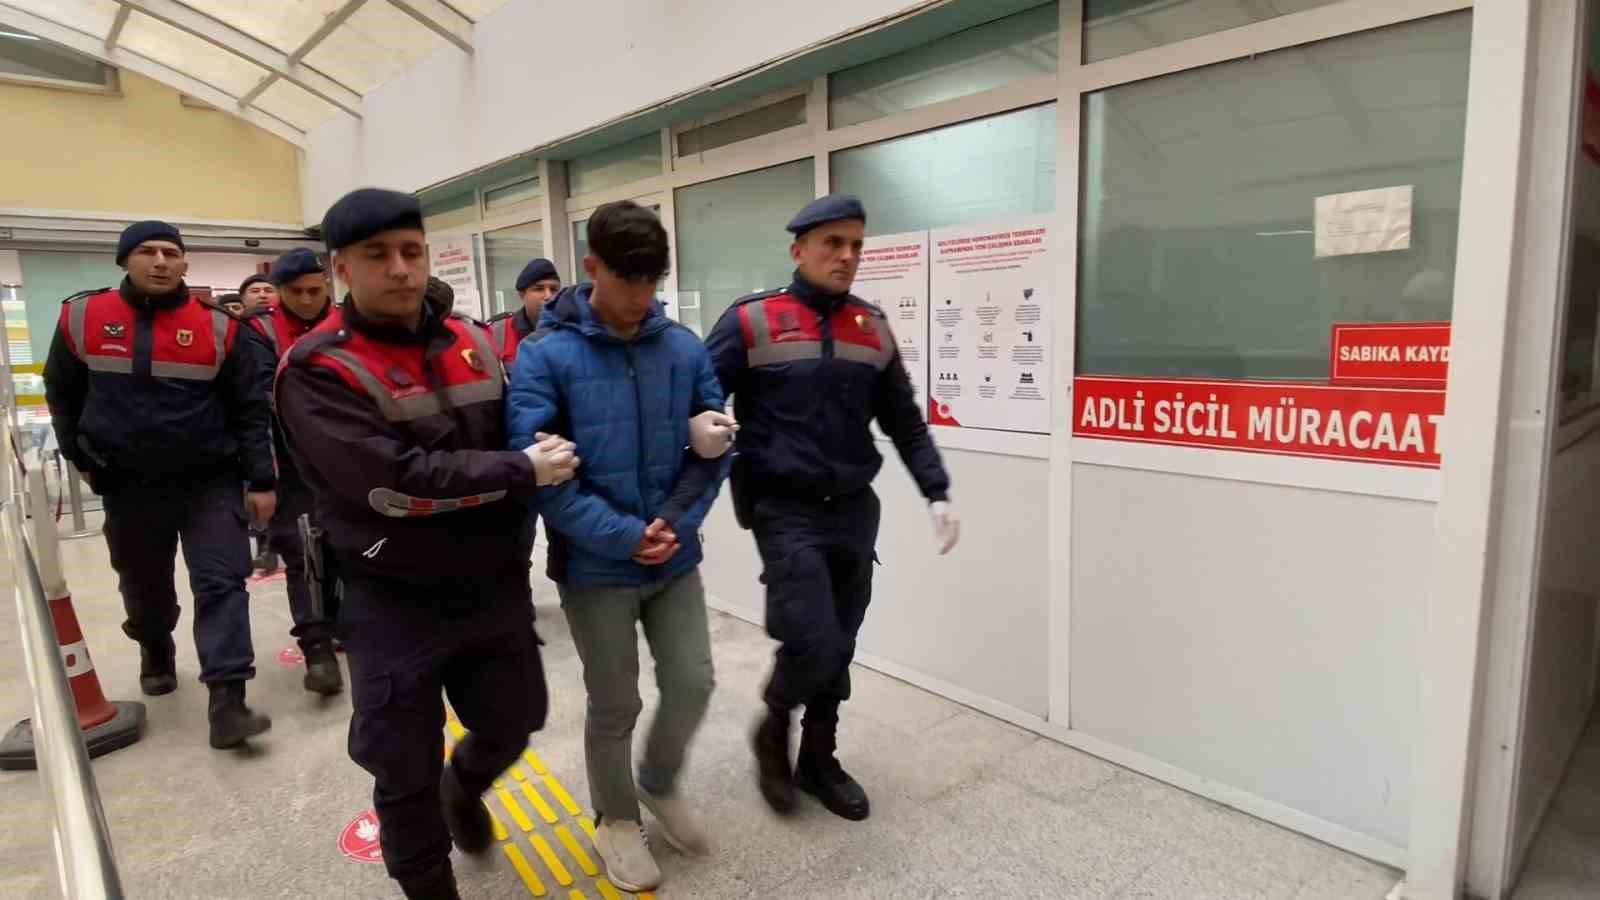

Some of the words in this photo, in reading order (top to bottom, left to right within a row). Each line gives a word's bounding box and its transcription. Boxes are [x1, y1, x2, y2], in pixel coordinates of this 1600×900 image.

[1339, 345, 1401, 362] SABIKA
[1081, 390, 1145, 431] ADLİ
[1153, 392, 1237, 439] SİCİL
[1248, 397, 1443, 454] MÜRACAAT
